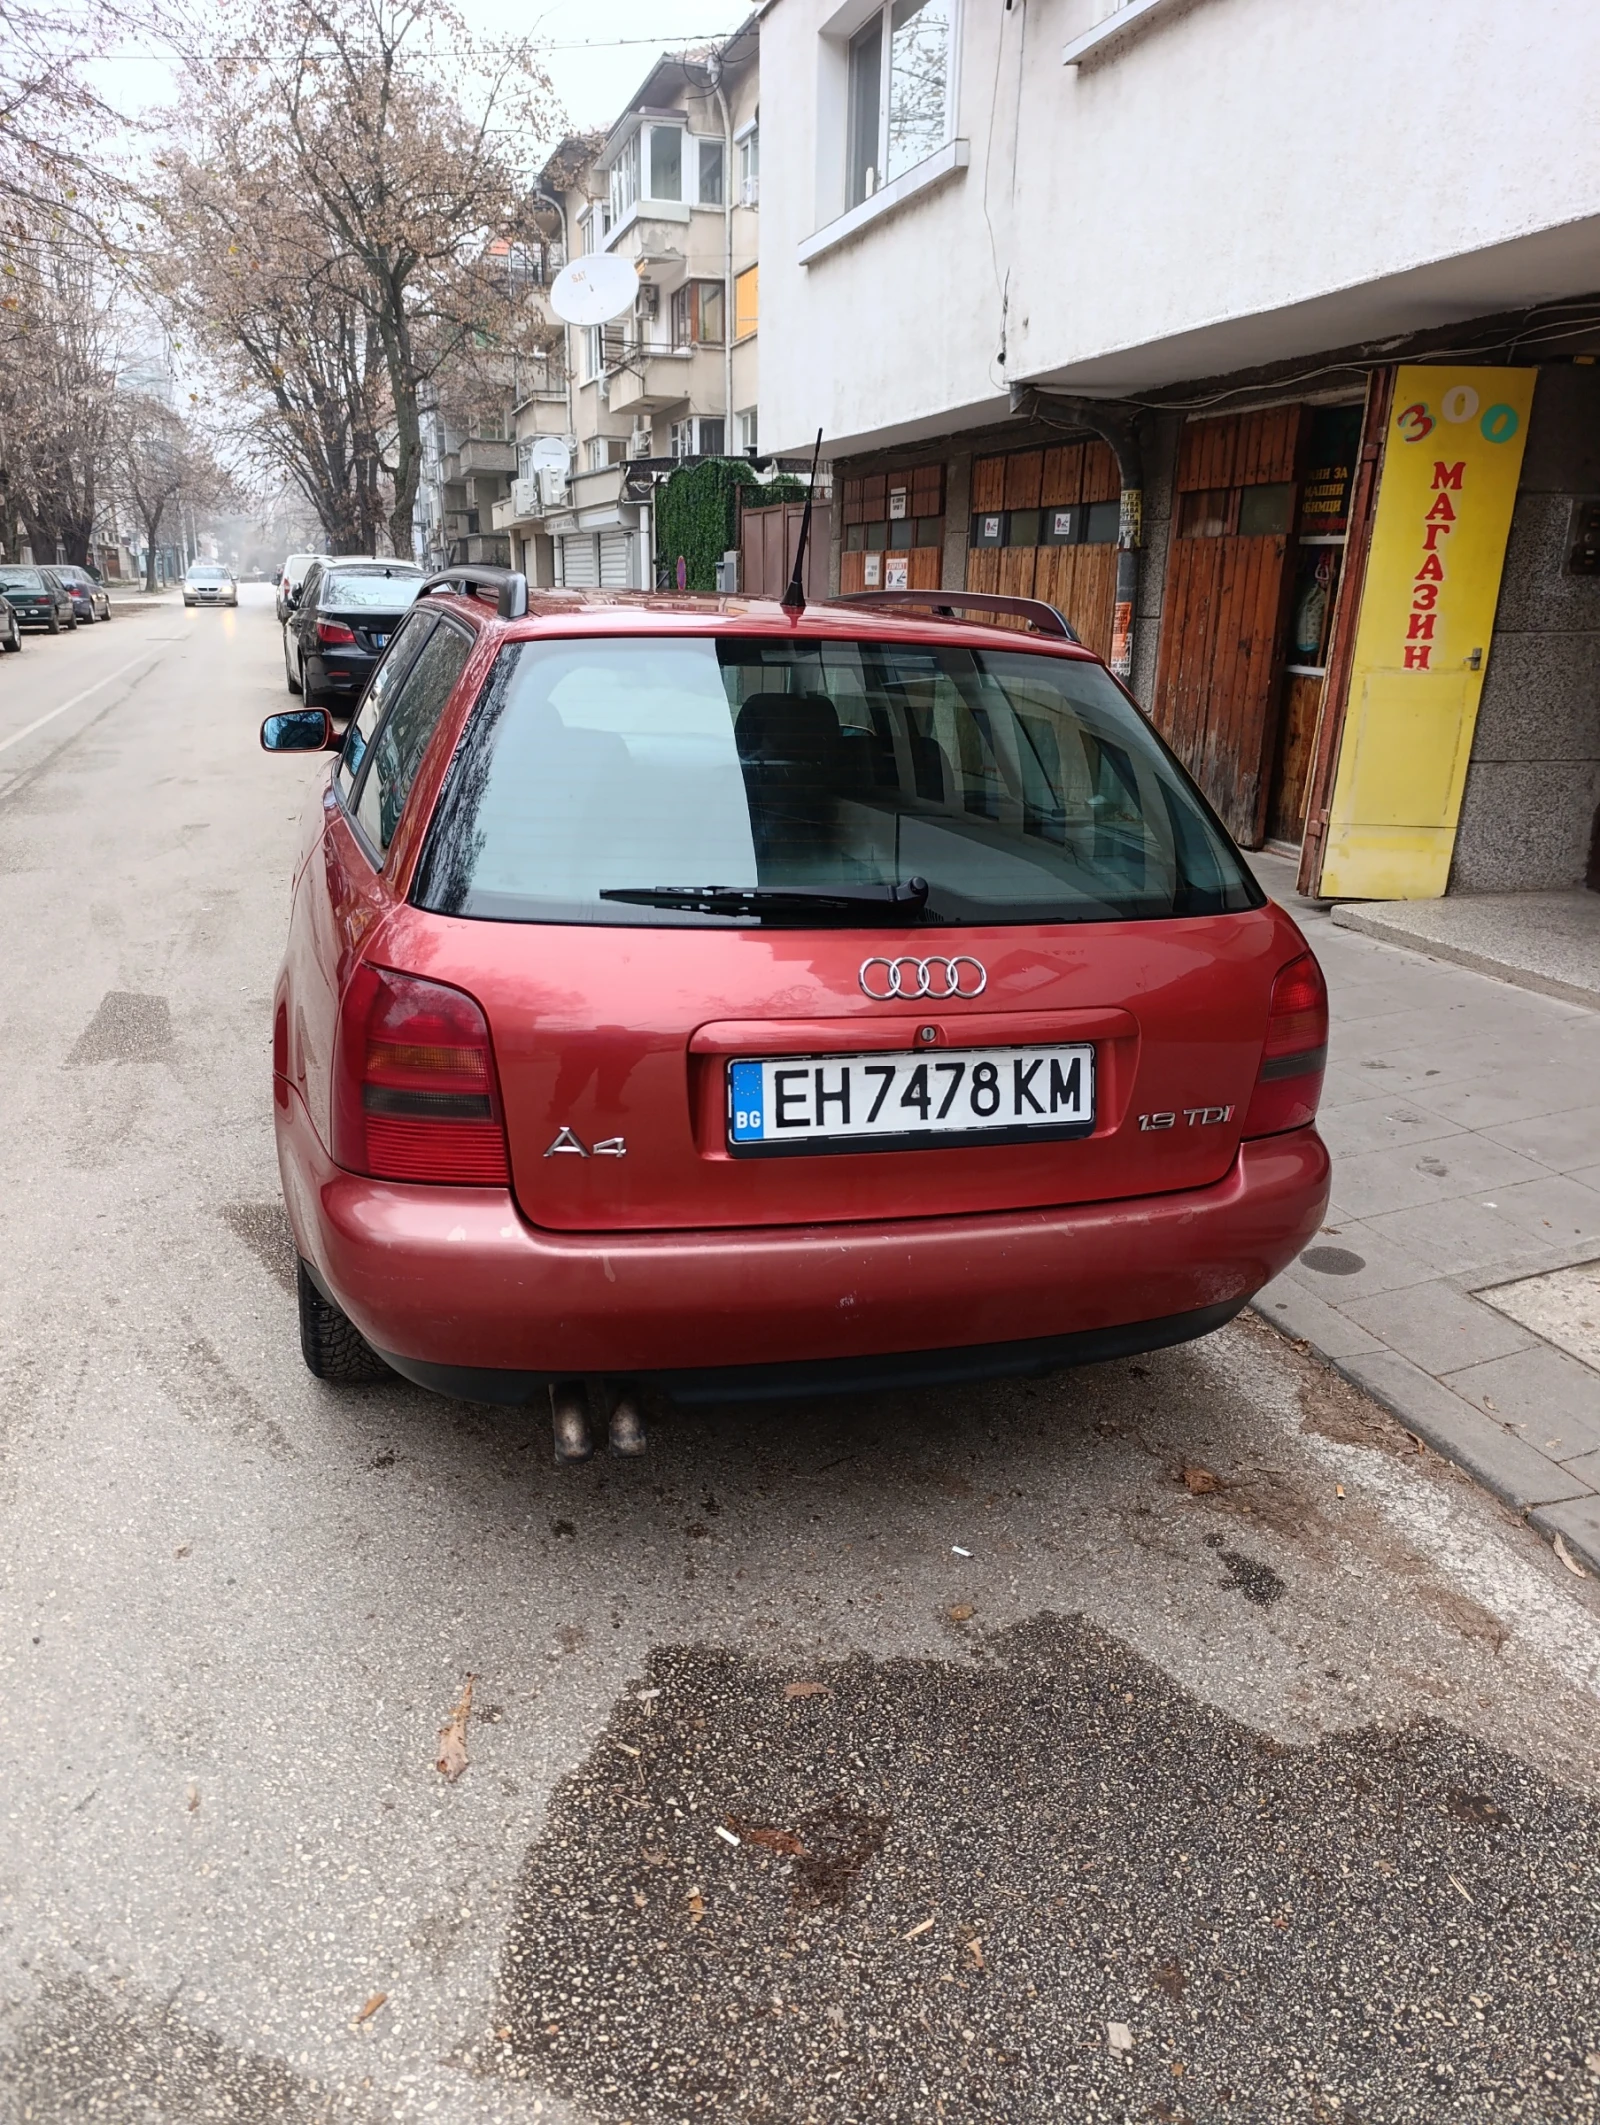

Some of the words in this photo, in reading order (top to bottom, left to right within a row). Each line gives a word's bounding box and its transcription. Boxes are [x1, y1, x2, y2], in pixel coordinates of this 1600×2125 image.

[1397, 385, 1519, 444] ЗОО
[1333, 466, 1348, 479] ЗА
[1402, 461, 1467, 670] МАГАЗИН
[736, 1110, 761, 1129] BG
[1183, 1105, 1236, 1126] TDI
[543, 1126, 627, 1158] A4
